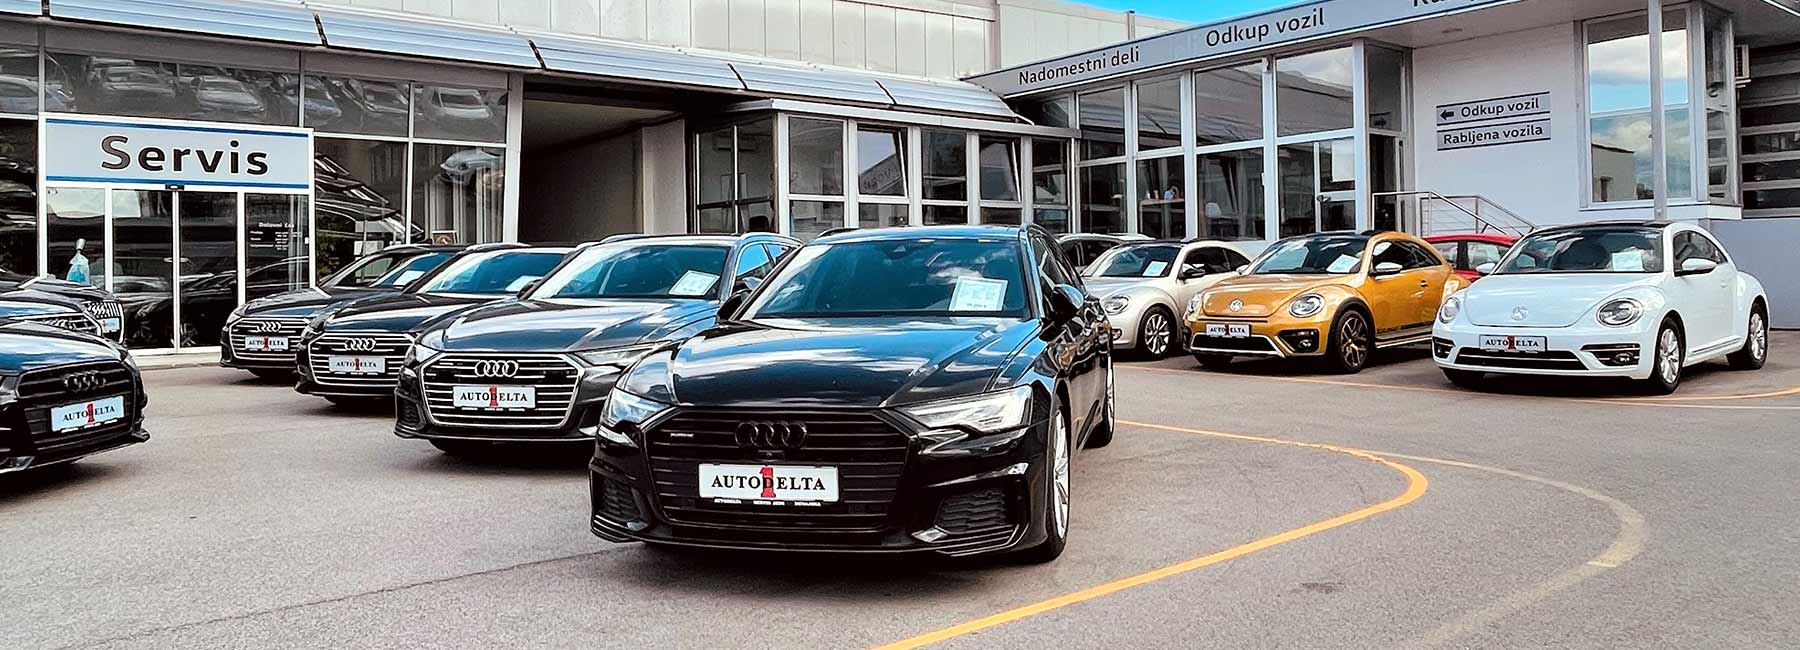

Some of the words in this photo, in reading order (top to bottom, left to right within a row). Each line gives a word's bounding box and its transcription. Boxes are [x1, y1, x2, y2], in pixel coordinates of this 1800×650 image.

[1206, 23, 1269, 46] Odkup
[1276, 7, 1325, 33] vozil
[1019, 53, 1106, 85] Nadomestni
[1111, 46, 1139, 66] deli
[1461, 104, 1504, 117] Odkup
[1508, 97, 1540, 111] vozil
[1444, 130, 1500, 144] Rabljena
[1503, 124, 1543, 138] vozila
[101, 135, 268, 175] Servis
[1485, 339, 1539, 347] AUTOELTA
